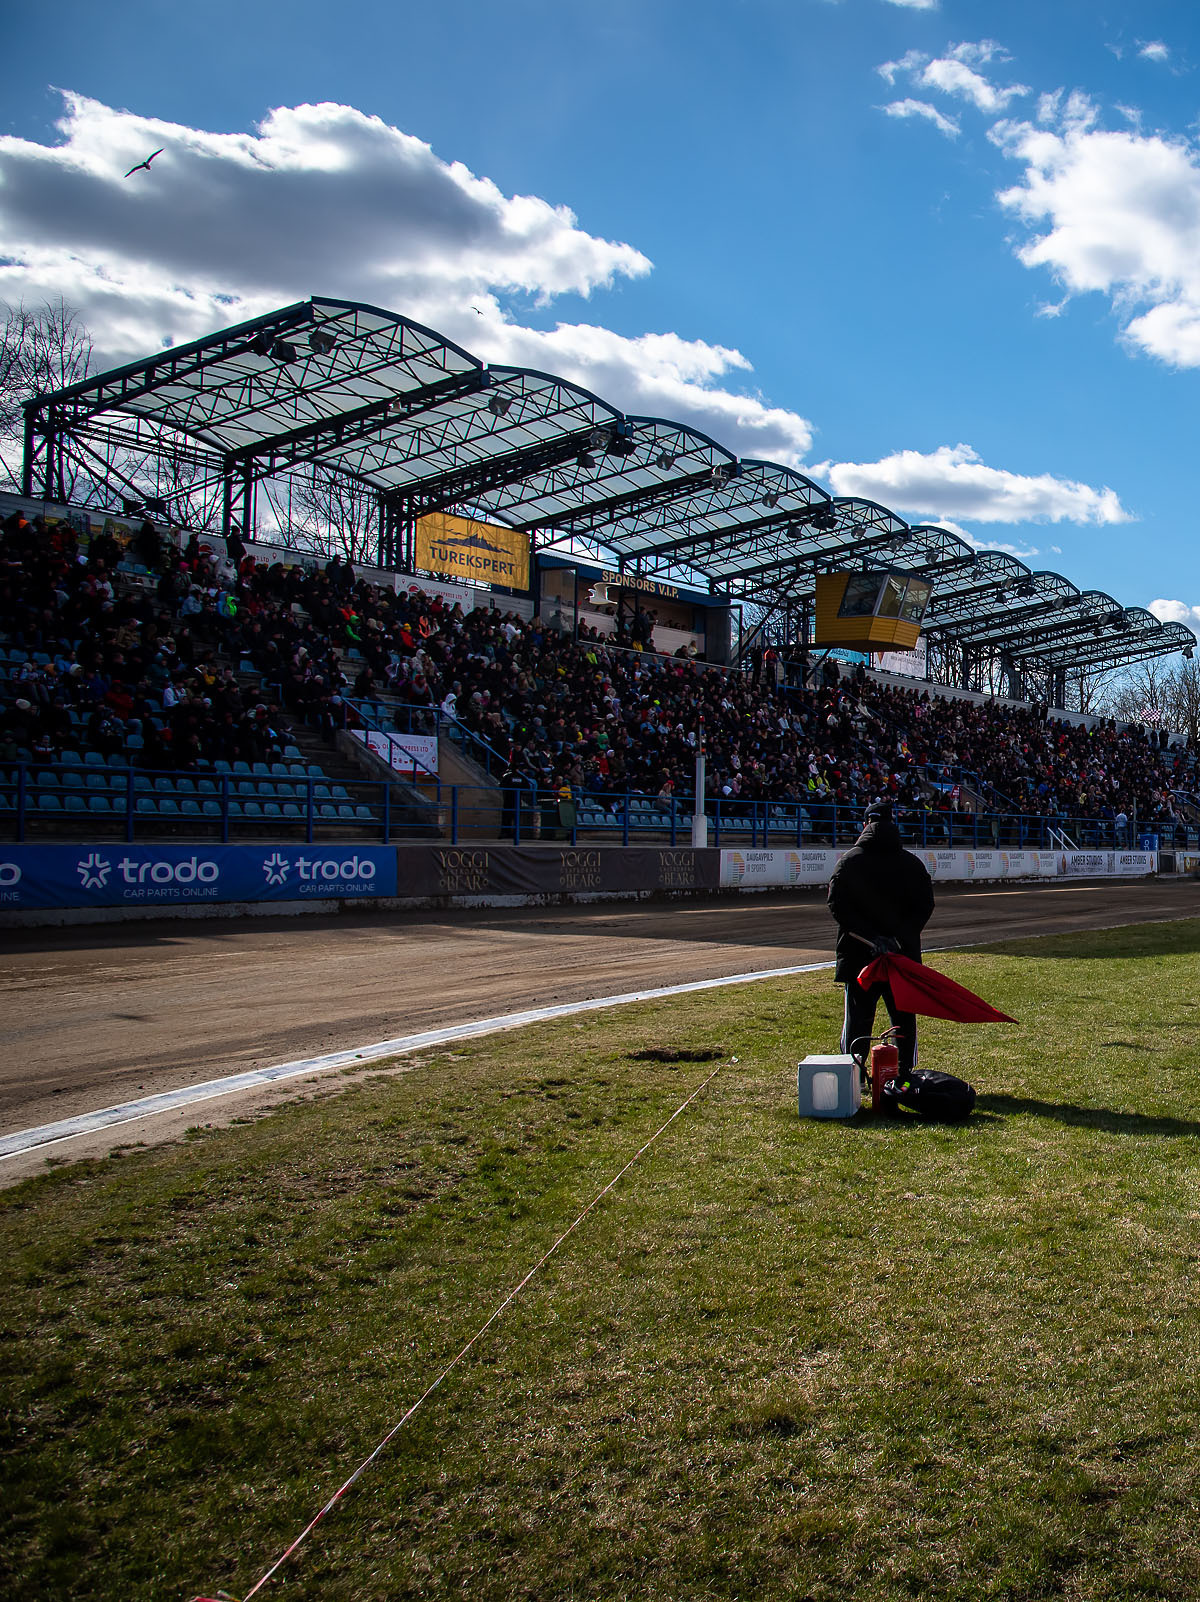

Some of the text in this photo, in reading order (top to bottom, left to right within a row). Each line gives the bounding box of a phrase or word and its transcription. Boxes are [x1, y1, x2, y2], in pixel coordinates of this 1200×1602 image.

[430, 547, 514, 575] TUREKSPERT
[602, 571, 679, 599] SPONSORS V.I.P.
[440, 851, 489, 868] YOGGI
[560, 851, 601, 867] YOGGI
[659, 851, 695, 866] YOGGI
[746, 853, 774, 861] DAUGAVPILS
[802, 853, 826, 861] DAUGAVPILS
[1071, 855, 1103, 865] AMBER STUDIOS
[1120, 855, 1147, 864] AMBER STUDIOS
[117, 856, 219, 883] trodo
[295, 856, 376, 880] trodo
[751, 864, 766, 872] SPORTS
[447, 875, 481, 891] BEAR
[566, 872, 595, 888] BEAR
[664, 872, 689, 885] BEAR
[124, 887, 218, 898] CAR PARTS ONLINE
[299, 883, 375, 893] CAR PARTS ONLINE
